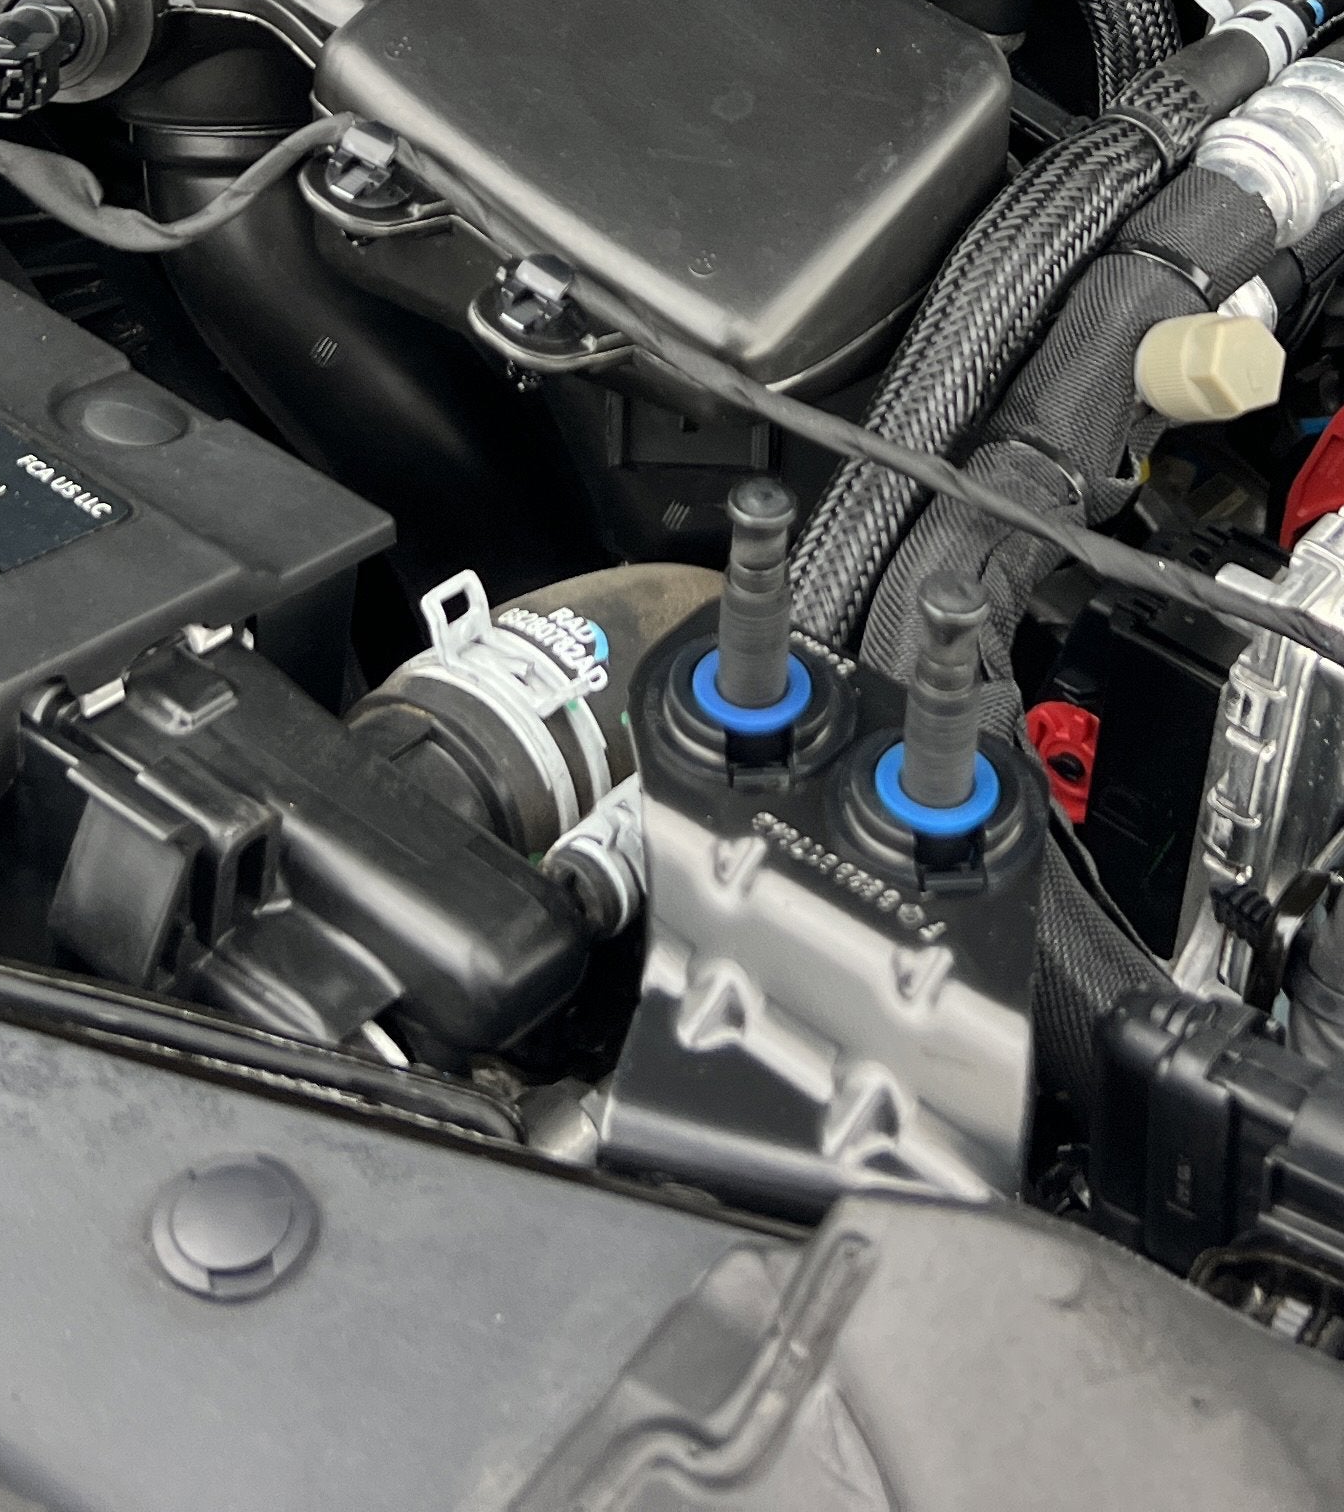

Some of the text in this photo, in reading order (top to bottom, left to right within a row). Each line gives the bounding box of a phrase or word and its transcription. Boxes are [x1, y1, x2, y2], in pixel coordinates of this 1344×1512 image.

[15, 453, 113, 520] FCA US LLC
[547, 607, 597, 644] RAD
